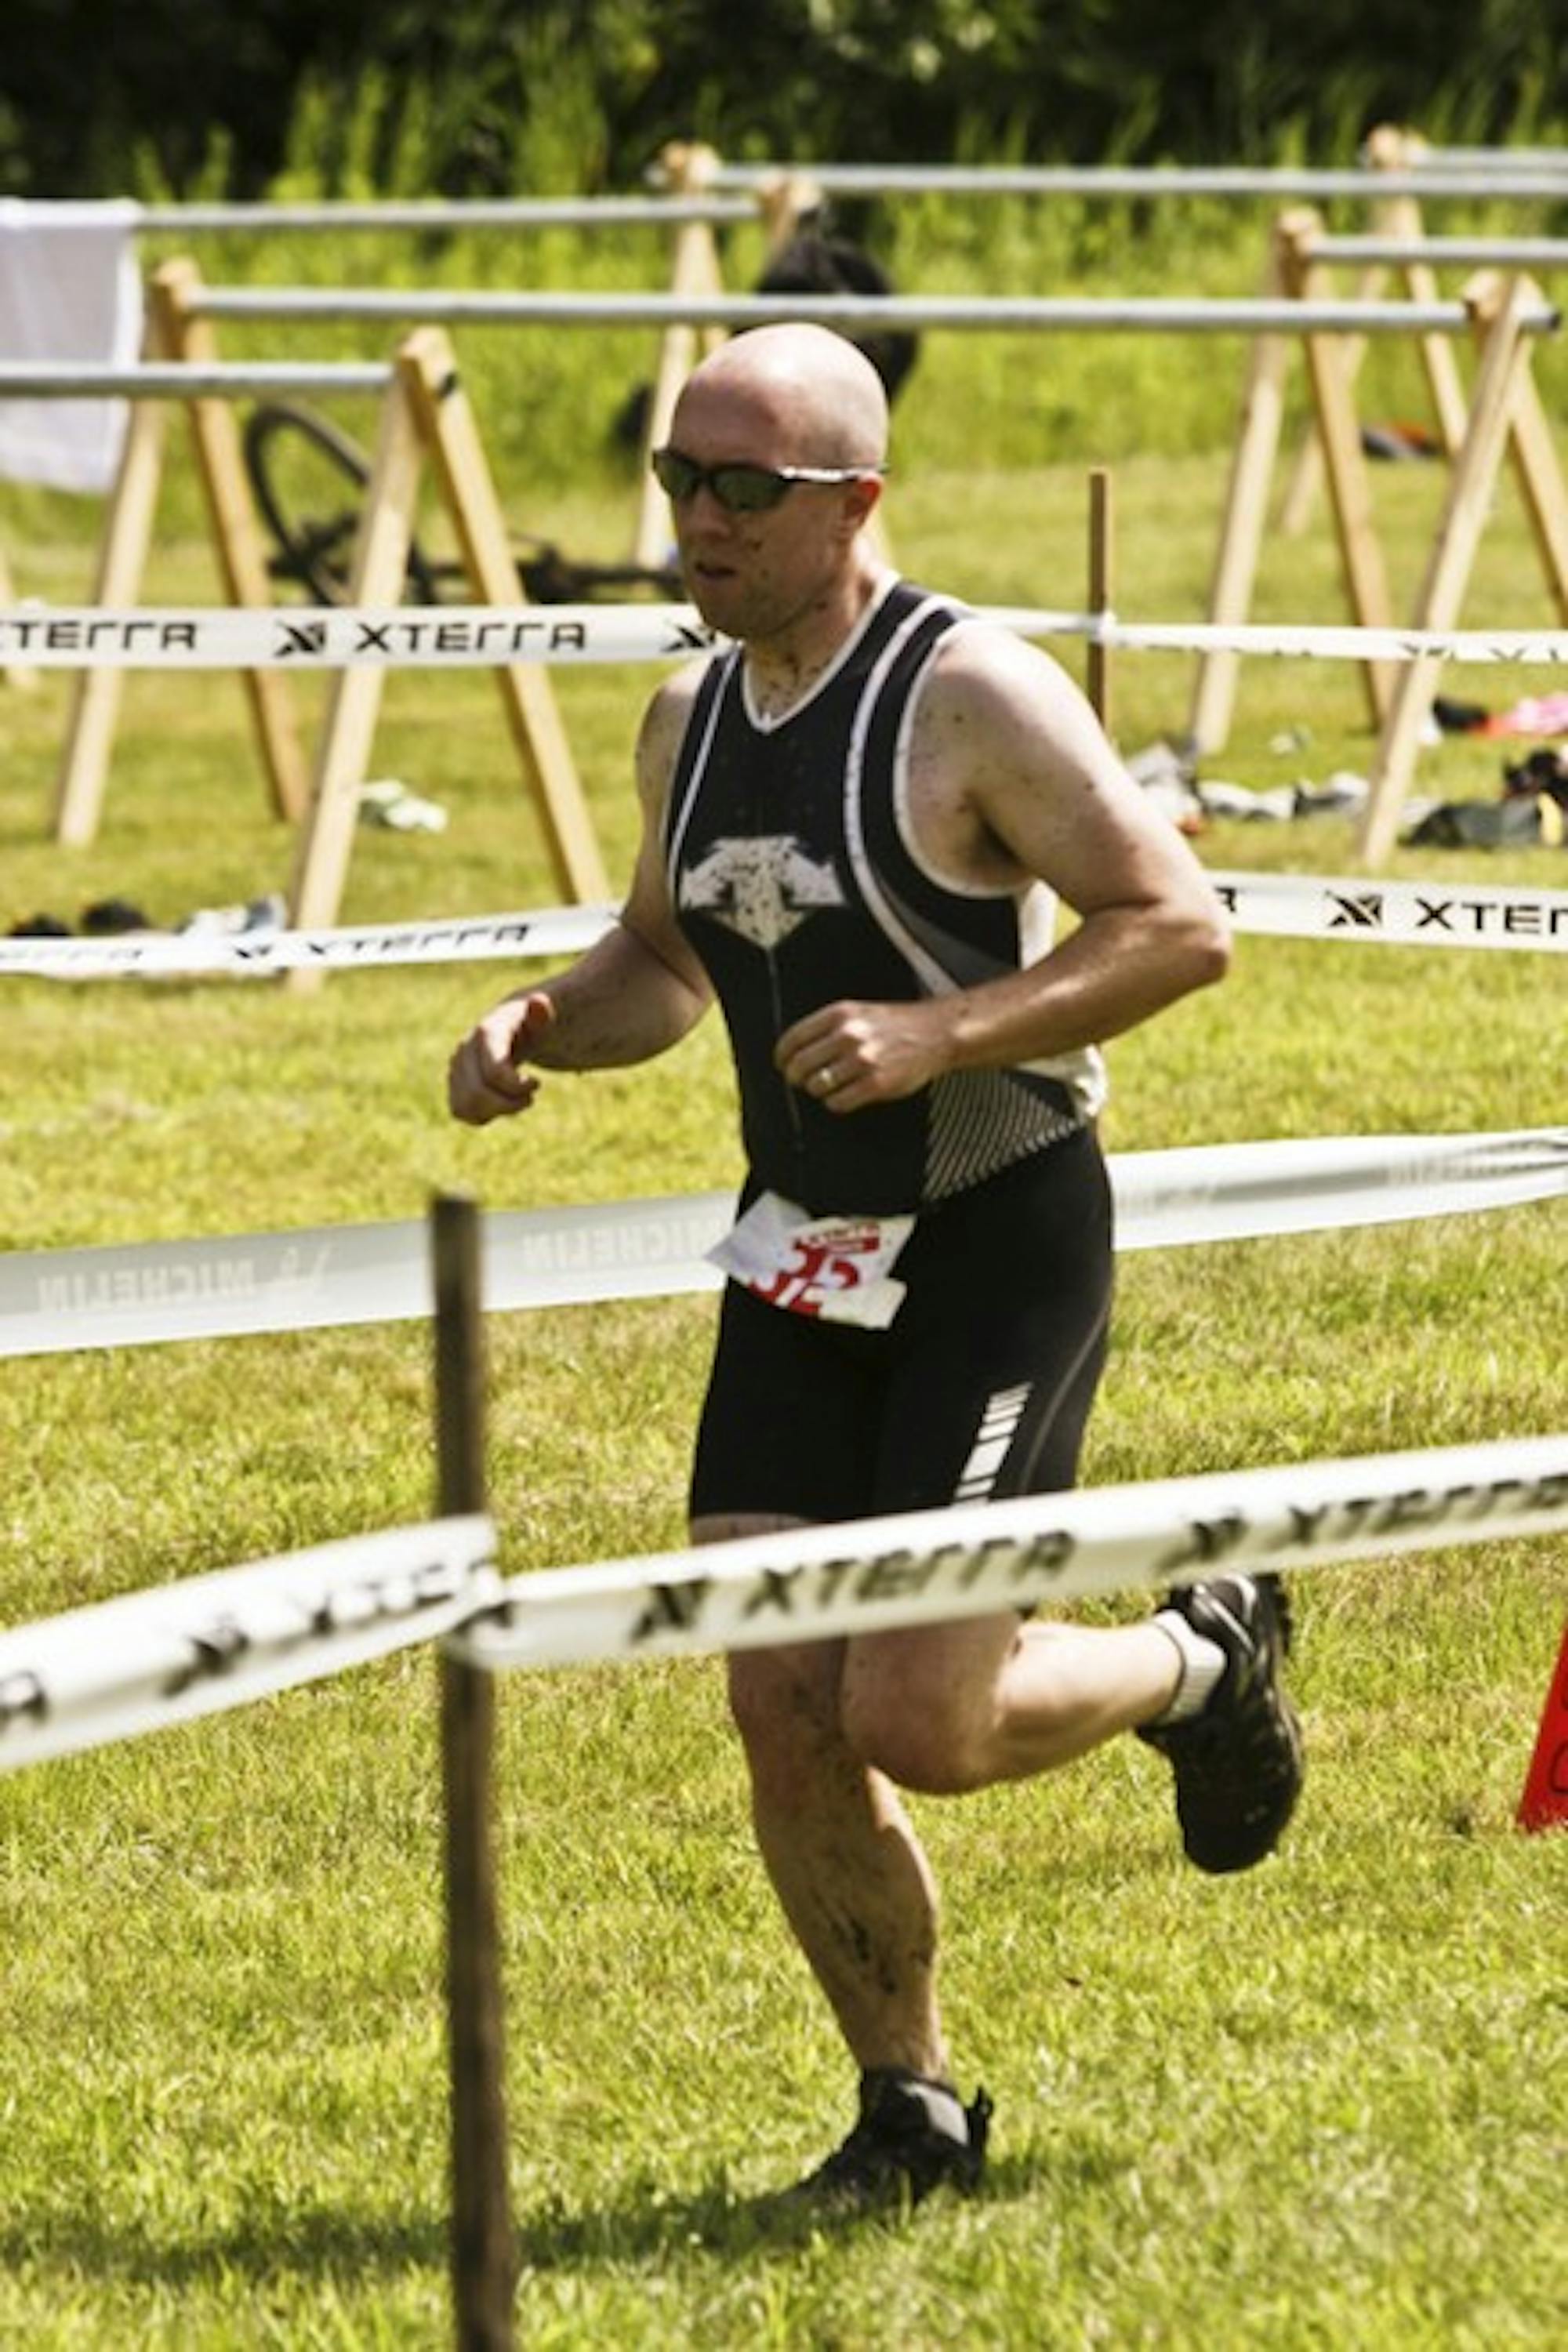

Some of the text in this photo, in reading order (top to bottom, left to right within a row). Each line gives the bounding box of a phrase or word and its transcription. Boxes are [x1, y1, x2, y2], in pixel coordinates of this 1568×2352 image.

[0, 620, 197, 650] TERRA
[354, 622, 586, 652] XTERRA
[740, 1529, 1077, 1618] XTERRA
